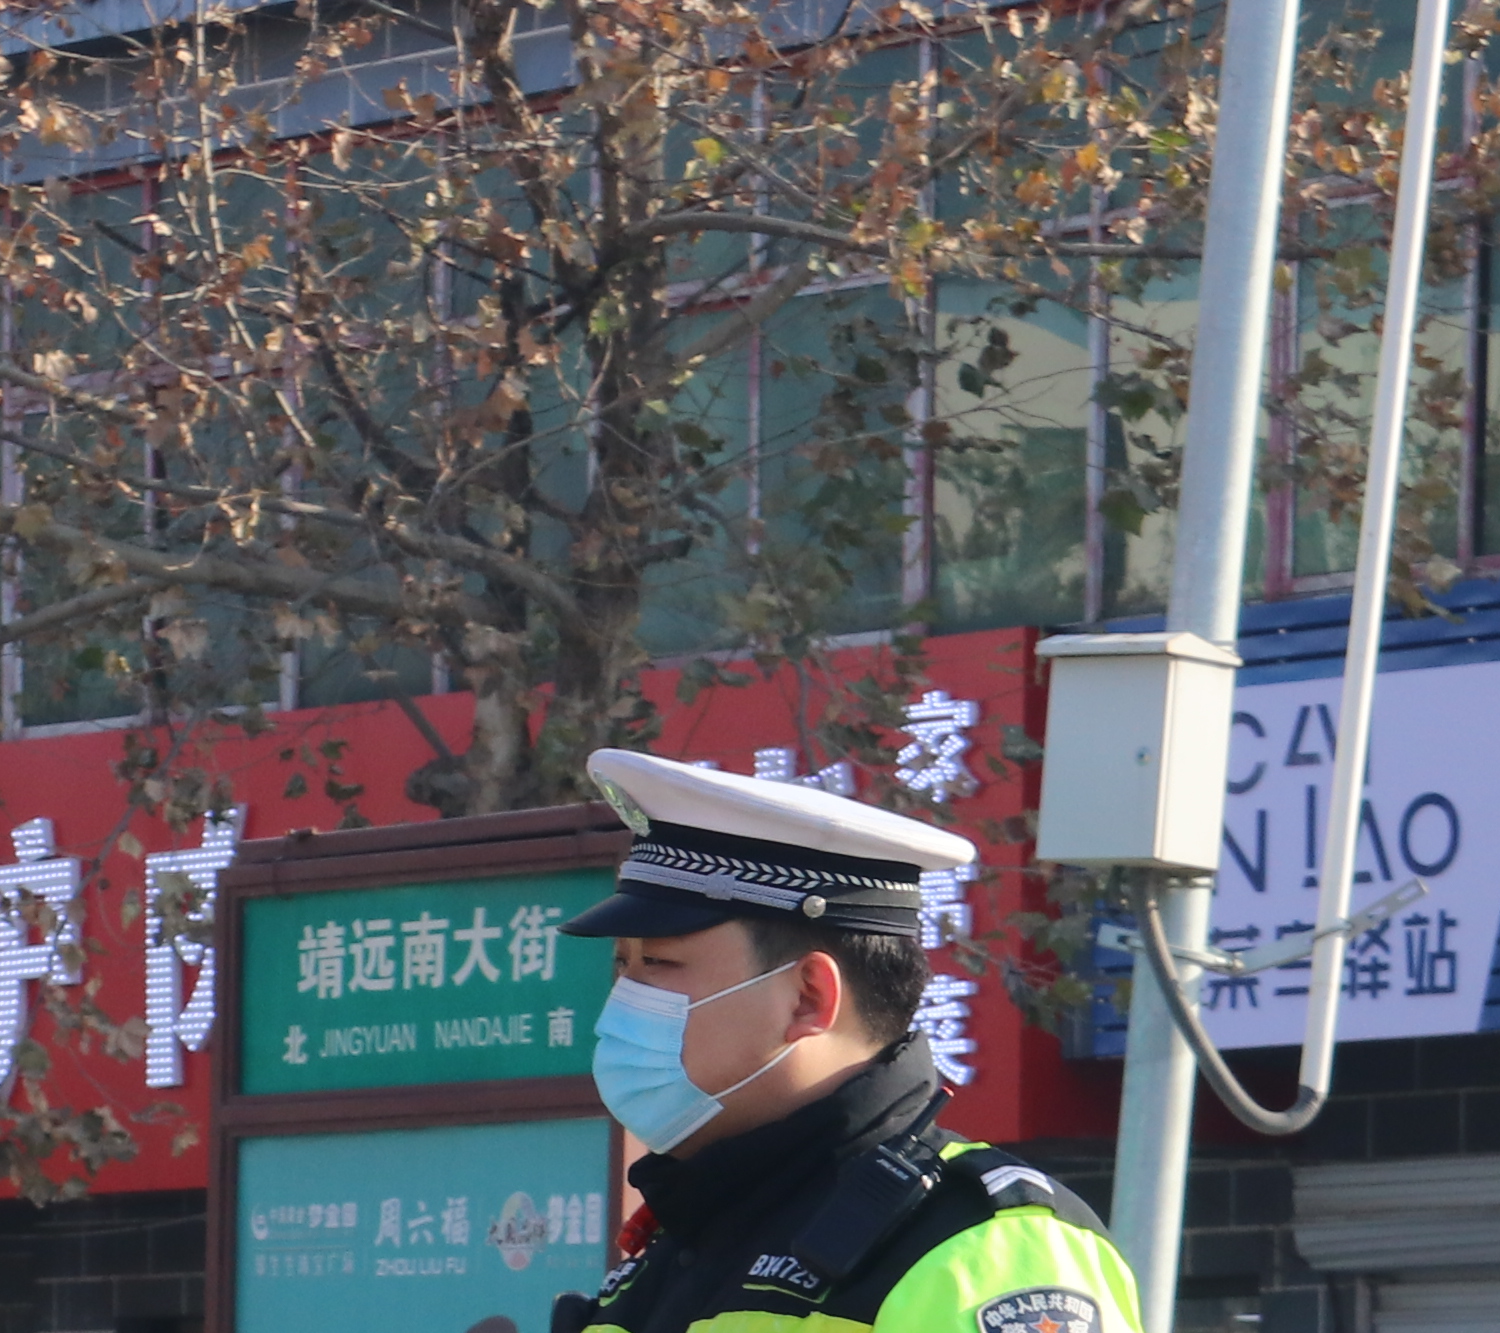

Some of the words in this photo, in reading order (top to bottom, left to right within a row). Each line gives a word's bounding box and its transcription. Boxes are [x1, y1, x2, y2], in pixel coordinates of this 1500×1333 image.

[297, 905, 558, 998] 靖远南大街
[283, 1025, 307, 1065] 北
[319, 1023, 416, 1059] JINGYUAN
[434, 1013, 532, 1049] NANDAJIE
[547, 1008, 574, 1048] 南
[374, 1196, 469, 1246] 周六福
[985, 1293, 1095, 1328] 中华人民共和国
